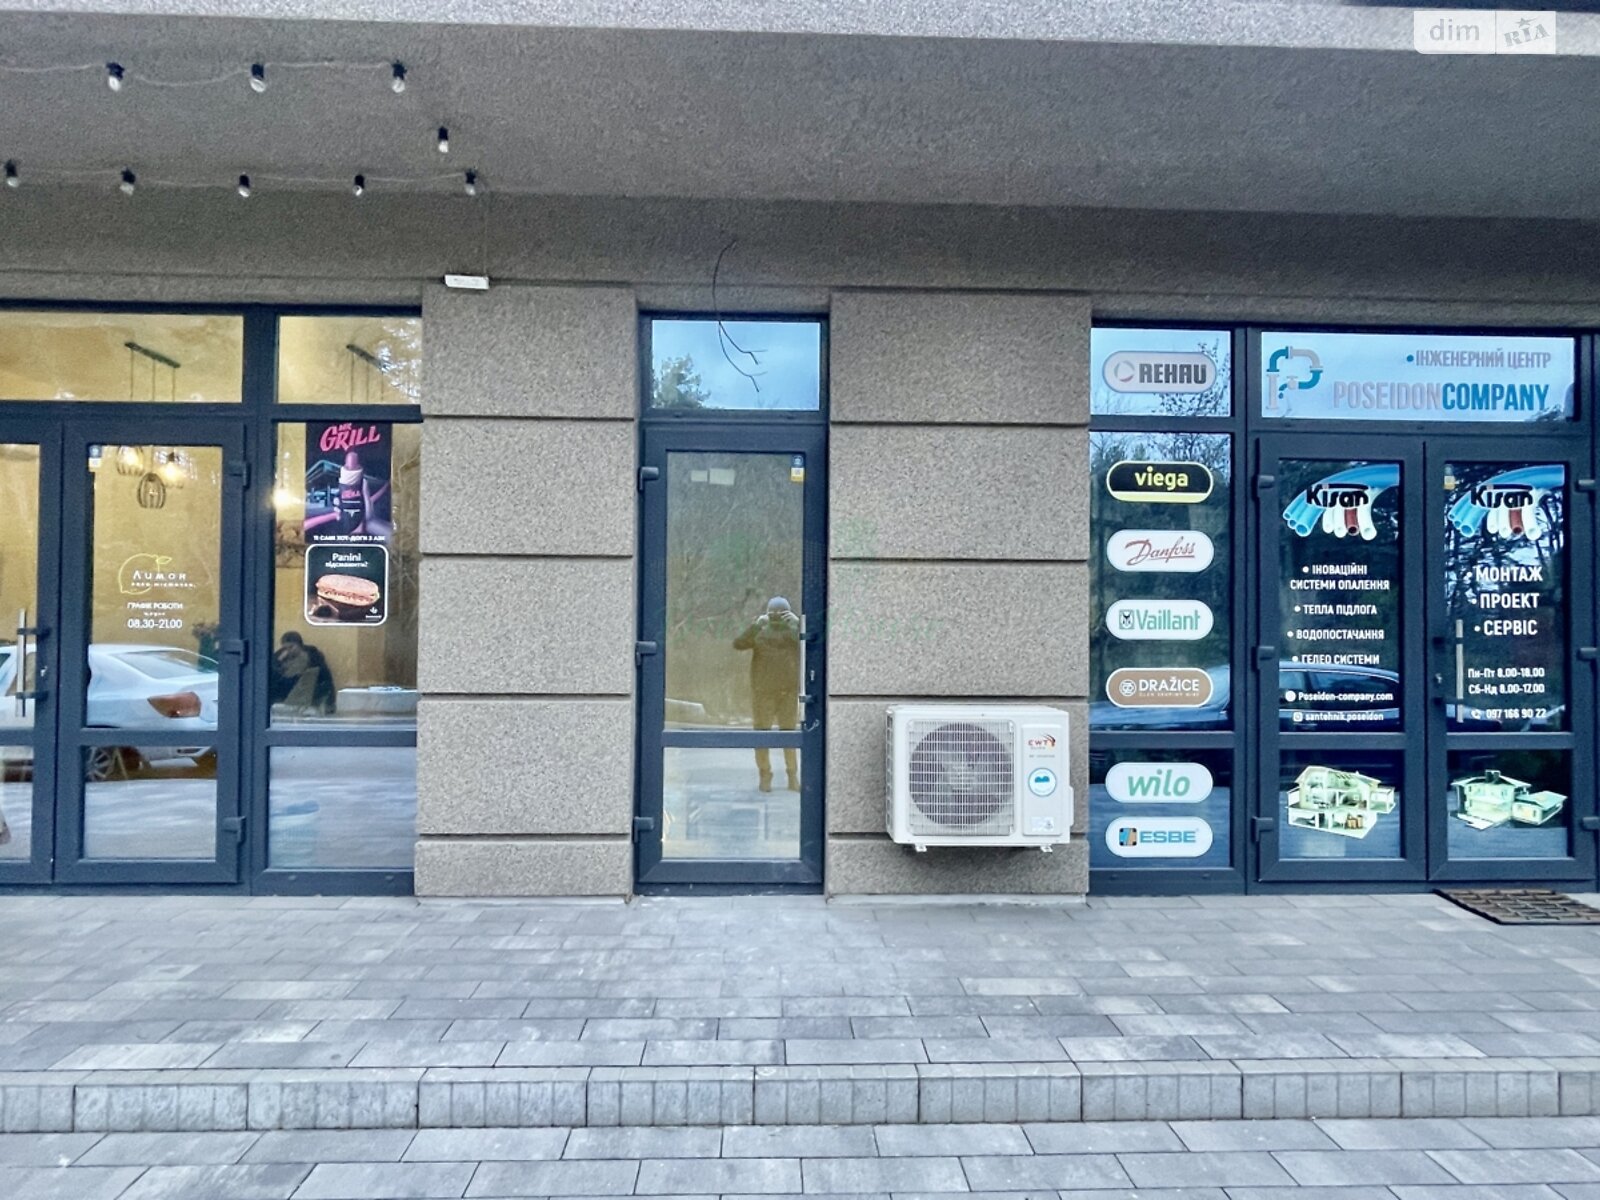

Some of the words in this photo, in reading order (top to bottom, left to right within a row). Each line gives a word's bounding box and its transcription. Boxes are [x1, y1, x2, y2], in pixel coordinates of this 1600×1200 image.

[1416, 349, 1503, 367] ІНЖЕНЕРНИЙ
[1507, 351, 1551, 369] ЦЕНТР
[1139, 363, 1207, 384] REHAU
[320, 425, 381, 452] GRILL
[1134, 466, 1188, 491] viega
[1306, 483, 1369, 508] Kisan
[1470, 484, 1533, 509] Kisan
[332, 553, 362, 562] Panini
[1124, 536, 1196, 566] Danfoss
[1312, 563, 1368, 576] ІНОВАЦІЙНІ
[1475, 566, 1543, 581] МОНТАЖ
[1290, 580, 1336, 590] СИСТЕМИ
[1338, 580, 1390, 590] ОПАЛЕННЯ
[1480, 593, 1540, 608] ПРОЕКТ
[1303, 604, 1334, 615] ТЕПЛА
[1336, 604, 1377, 616] ПІДЛОГА
[1136, 609, 1200, 631] Vaillant
[1483, 620, 1538, 635] СЕРВІС
[1296, 629, 1384, 640] ВОДОПОСТАЧАННЯ
[1302, 655, 1332, 664] ГЕЛЕО
[1334, 654, 1380, 664] СИСТЕМИ
[1468, 668, 1495, 678] Пн-Пт
[1497, 667, 1545, 678] 8.00-18.00
[1138, 676, 1200, 691] DRAŽICE
[1468, 684, 1498, 695] Сб-Нд
[1298, 691, 1394, 702] Poseidon-company.com
[1486, 709, 1501, 718] 097
[1535, 708, 1546, 718] 22
[1127, 769, 1191, 797] wilo
[1139, 831, 1197, 844] ESBE
